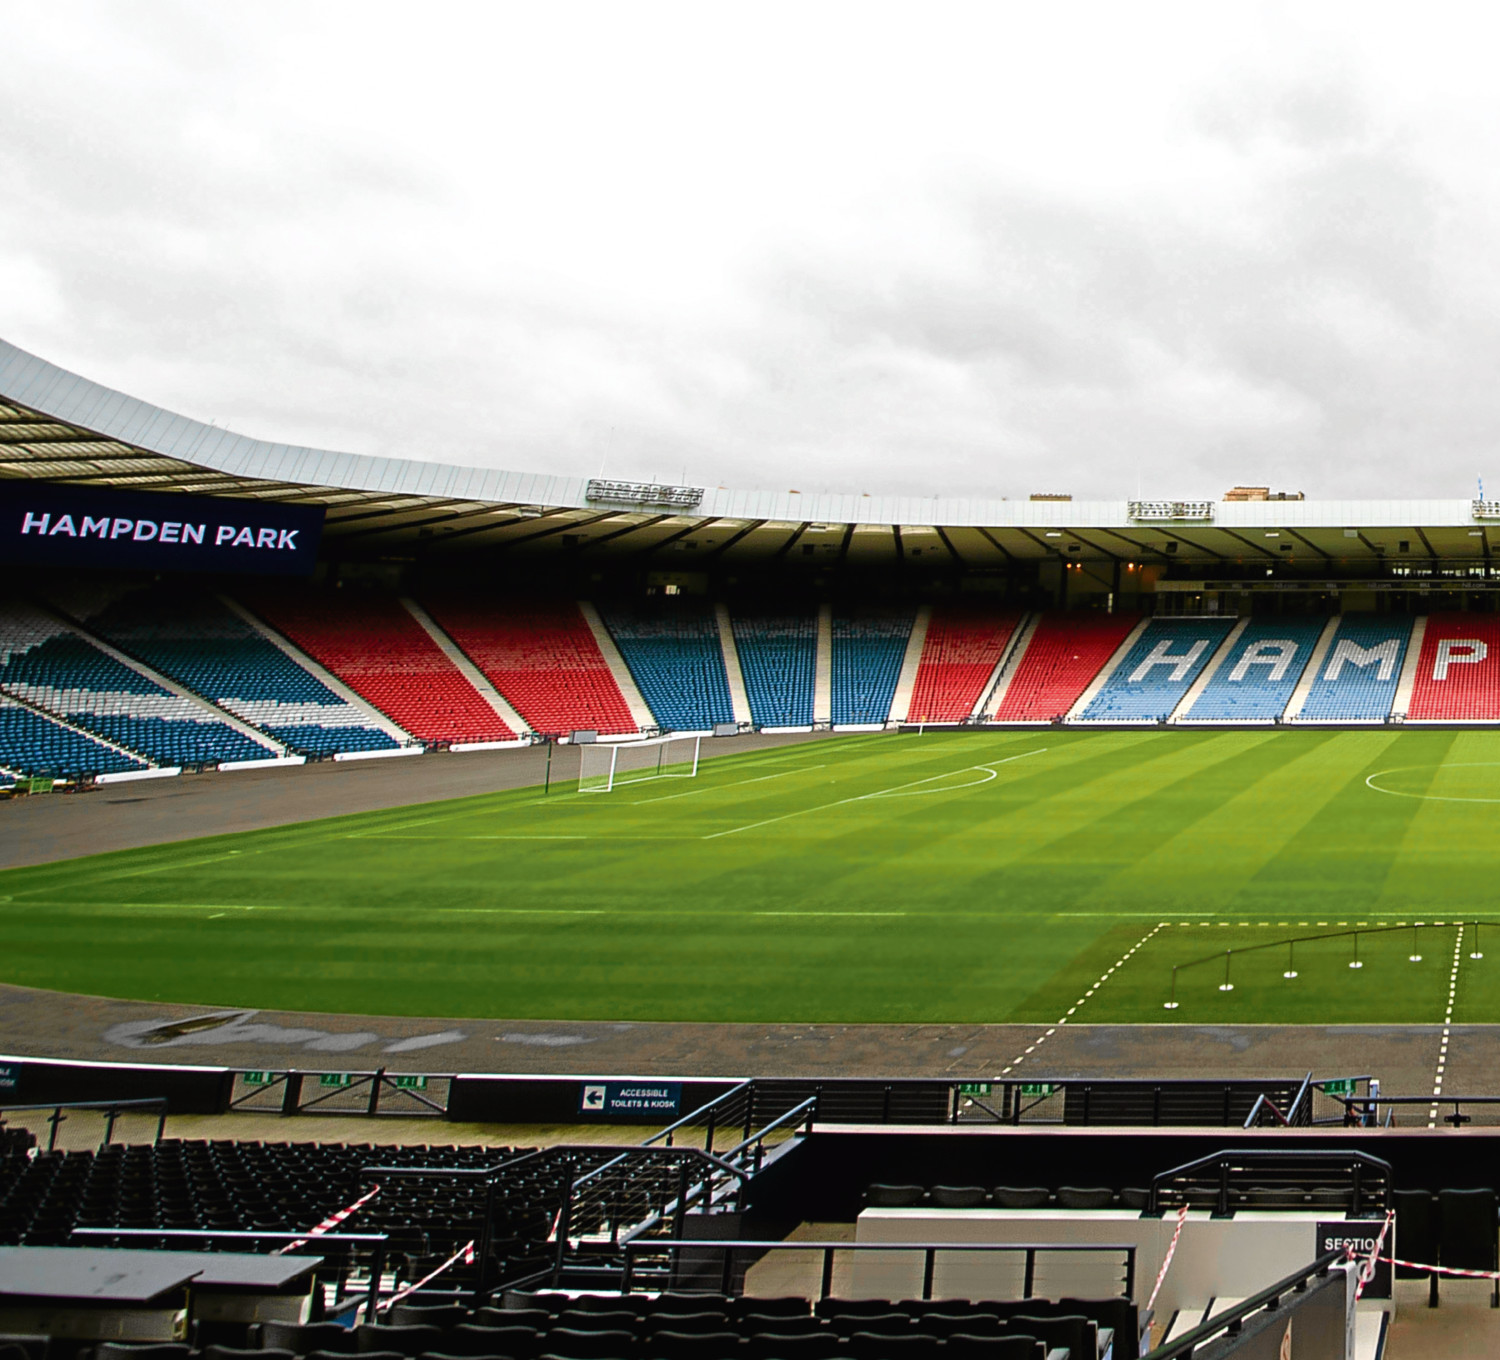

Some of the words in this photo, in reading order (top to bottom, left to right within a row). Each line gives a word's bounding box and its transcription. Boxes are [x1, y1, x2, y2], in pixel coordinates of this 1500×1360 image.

[21, 512, 205, 544] HAMPDEN
[215, 525, 299, 550] PARK
[620, 1088, 668, 1097] ACCESSIBLE
[611, 1099, 641, 1108] TOILETS
[651, 1100, 675, 1108] KIOSK
